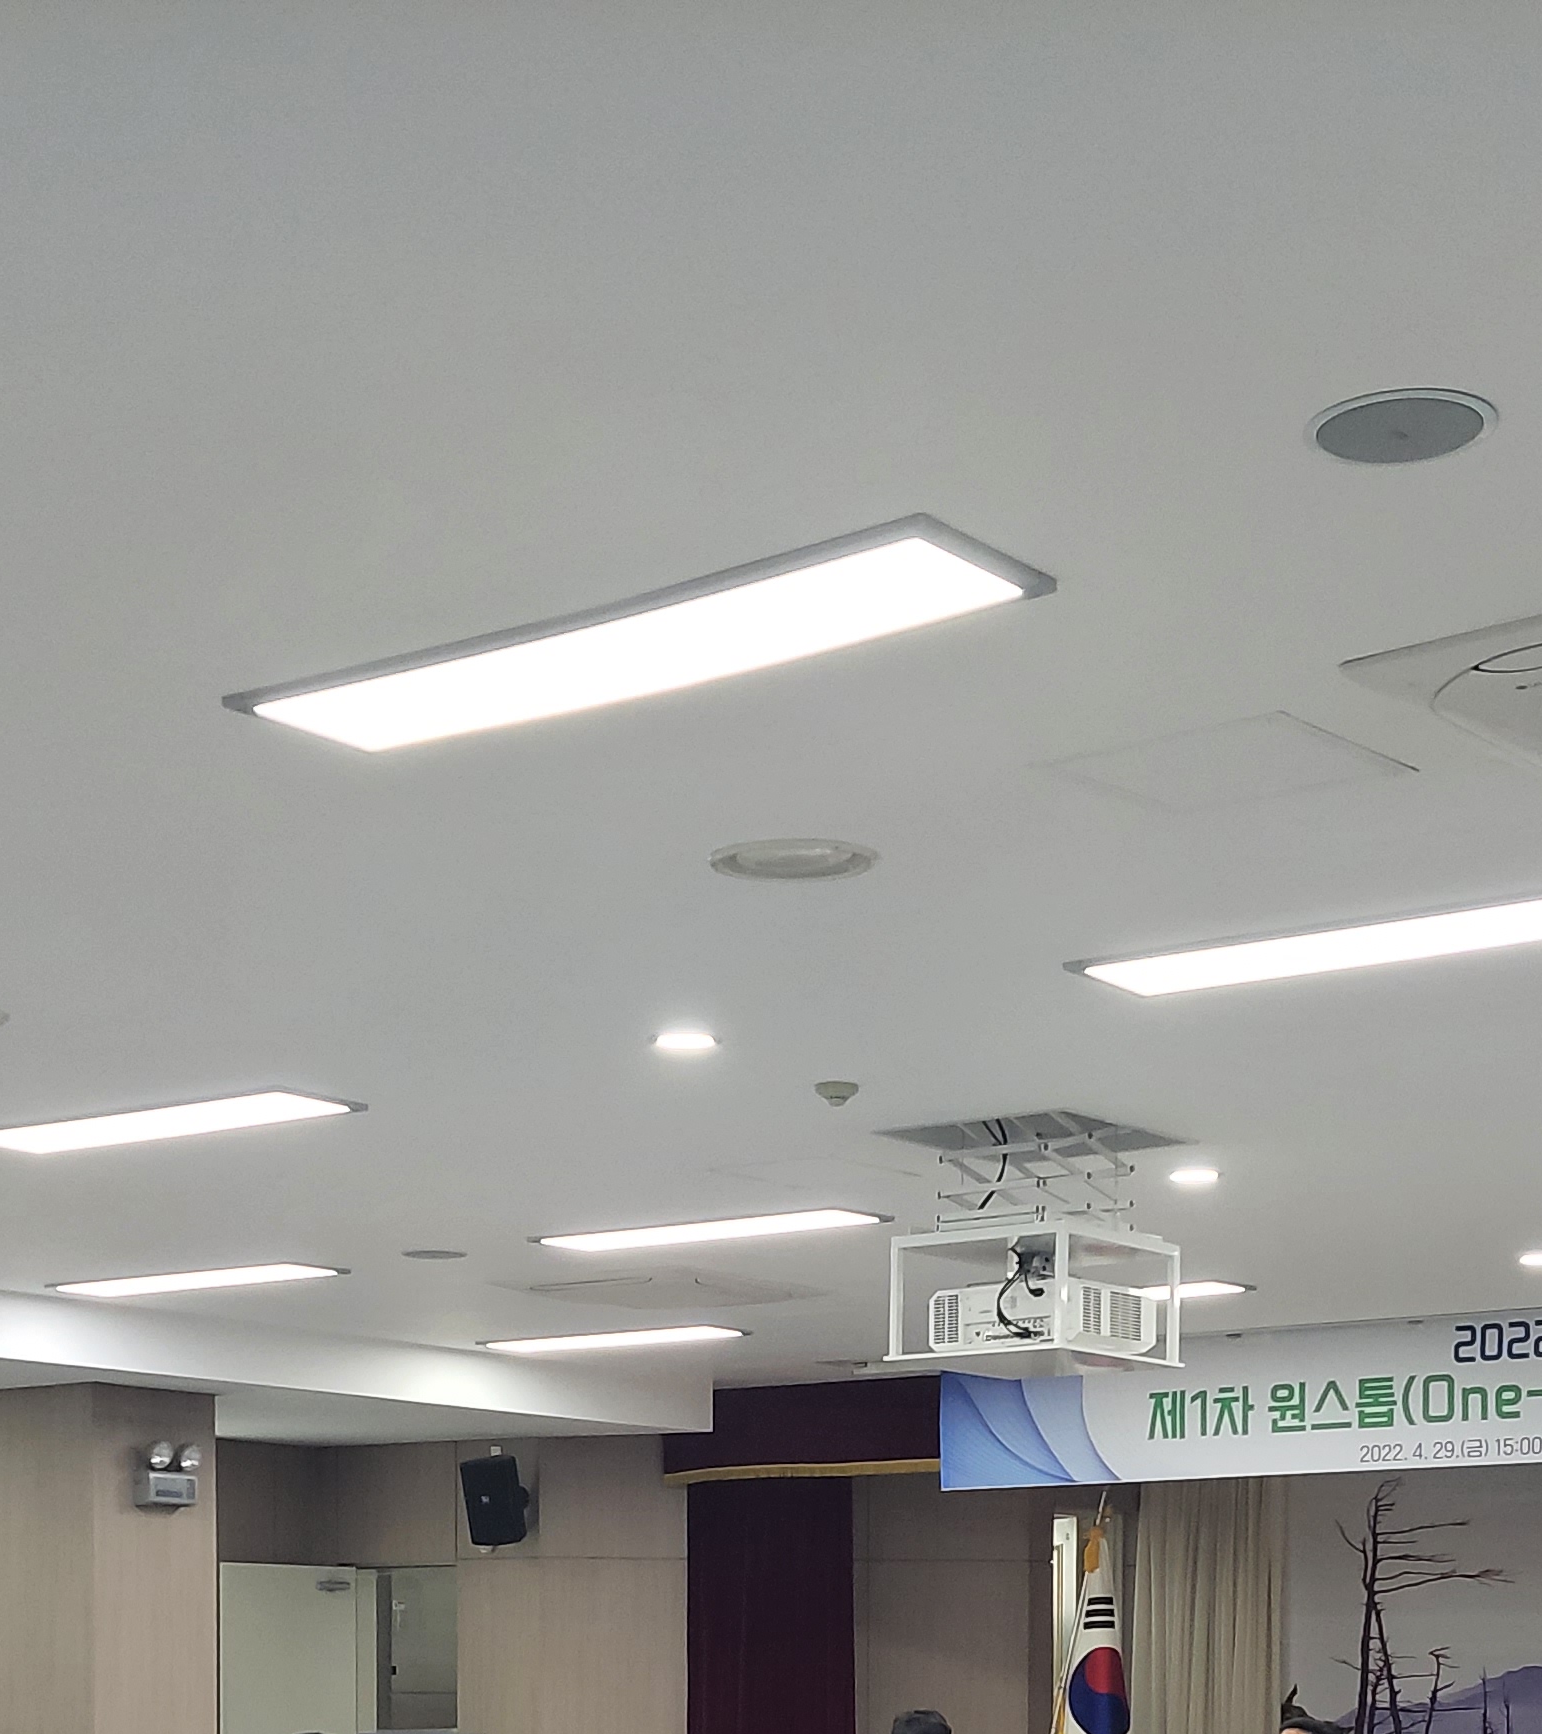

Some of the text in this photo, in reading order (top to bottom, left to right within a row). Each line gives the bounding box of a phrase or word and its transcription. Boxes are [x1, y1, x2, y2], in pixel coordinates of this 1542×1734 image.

[1147, 1384, 1255, 1440] 제1차
[1359, 1443, 1409, 1463] 2022.
[1412, 1442, 1428, 1461] 4.
